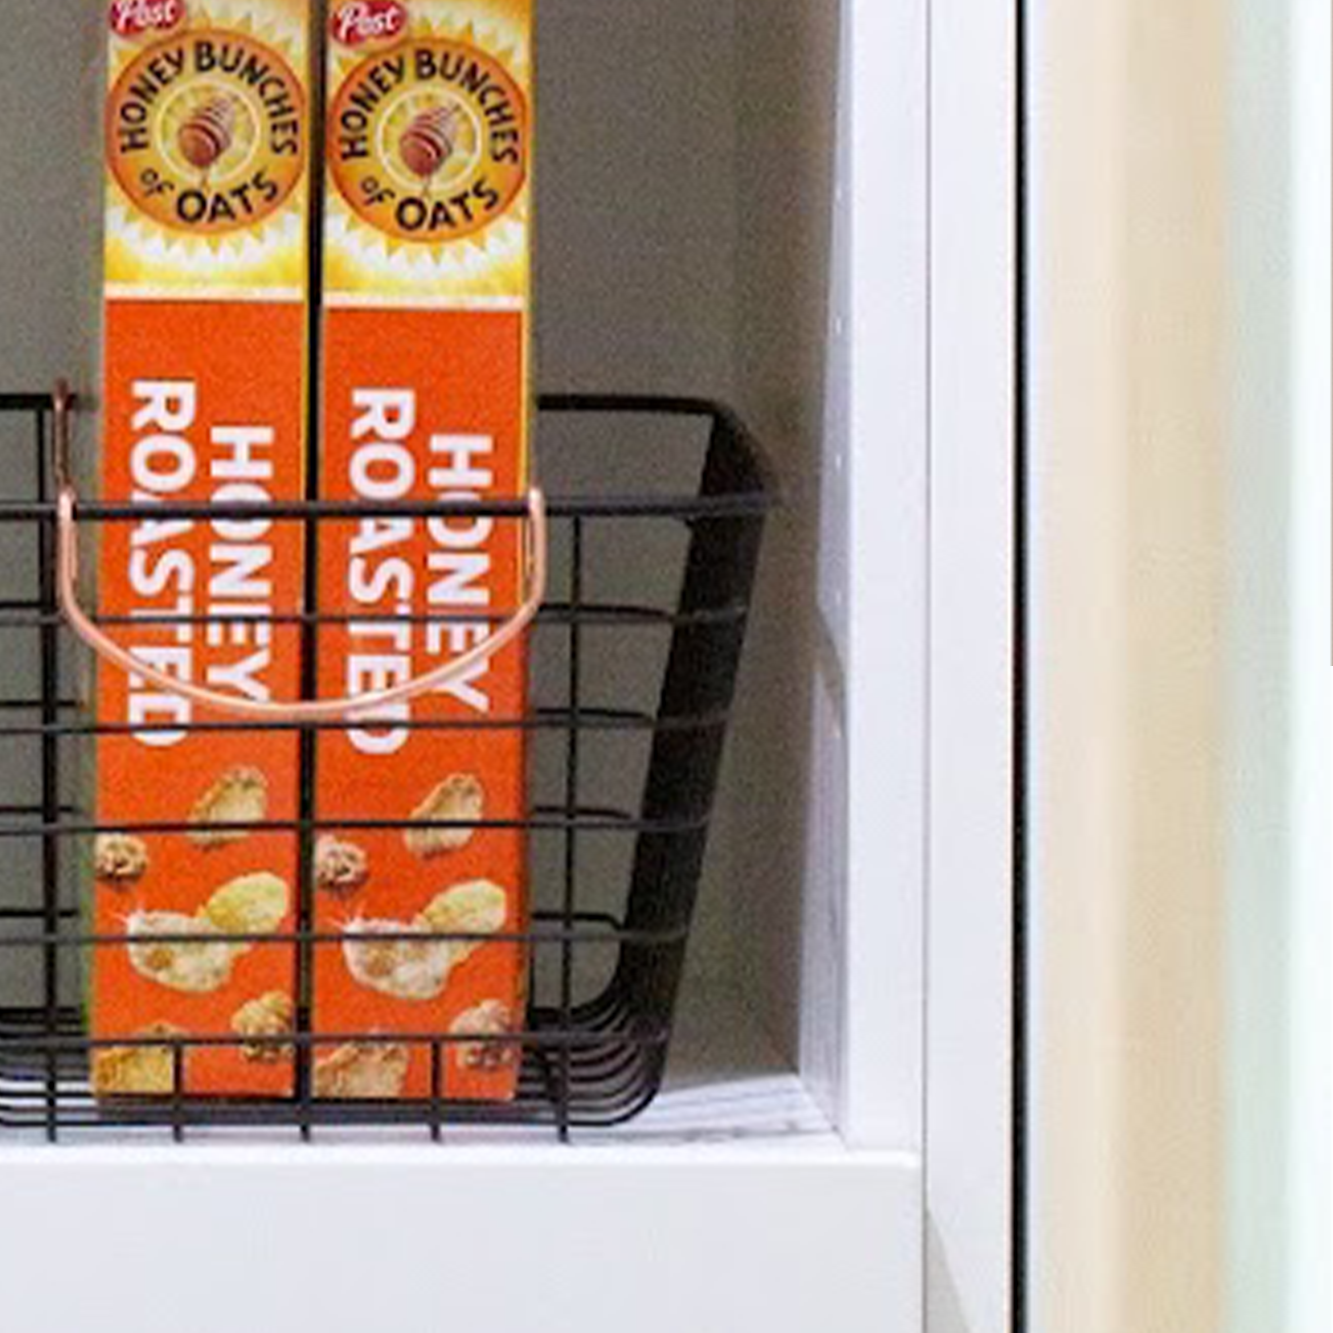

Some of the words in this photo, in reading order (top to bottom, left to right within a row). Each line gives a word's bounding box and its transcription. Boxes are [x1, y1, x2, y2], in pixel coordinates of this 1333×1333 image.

[332, 3, 399, 41] Post
[120, 46, 186, 153] HONEY
[194, 40, 299, 156] BUNCHES
[340, 54, 407, 160] HONEY
[414, 49, 520, 164] BUNCHES
[140, 166, 176, 199] OF
[176, 169, 280, 223] OATS
[360, 175, 396, 207] OF
[395, 177, 500, 231] OATS
[127, 379, 197, 747] ROASTED
[206, 425, 276, 704] HONEY
[344, 387, 416, 755] ROASTED
[426, 433, 494, 714] HONEY
